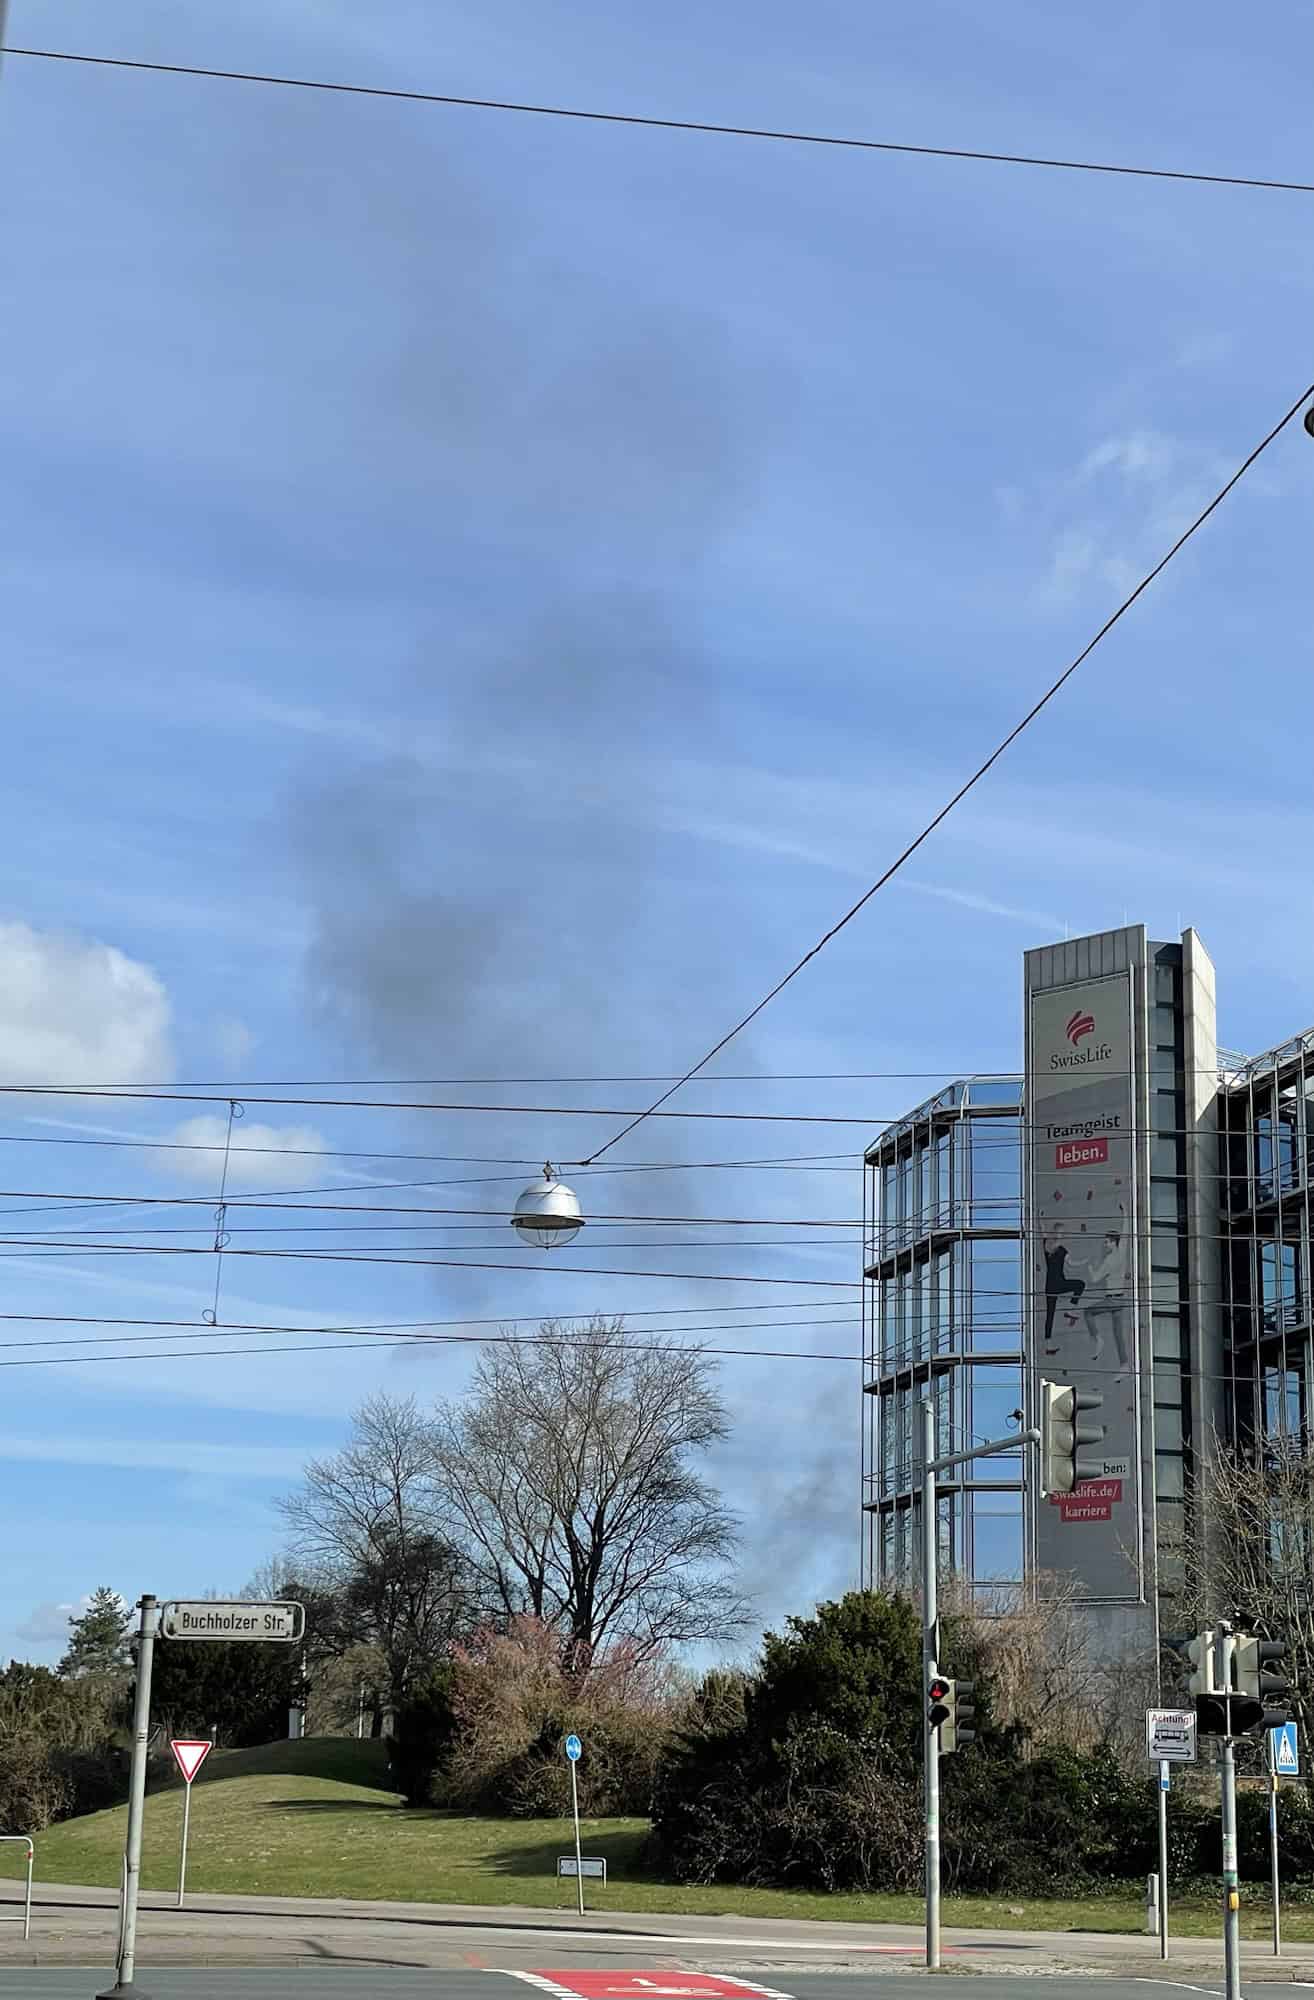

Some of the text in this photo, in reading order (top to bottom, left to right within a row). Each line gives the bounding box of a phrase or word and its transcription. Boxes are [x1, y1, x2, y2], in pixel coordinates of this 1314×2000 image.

[1050, 1043, 1112, 1070] SwissLife
[1046, 1113, 1120, 1139] Teamgeist
[1058, 1144, 1105, 1165] leben.
[1104, 1462, 1126, 1474] ben:
[1065, 1504, 1107, 1518] karriere
[182, 1612, 285, 1630] Buchholzer Str.
[1152, 1713, 1192, 1726] Achtung!
